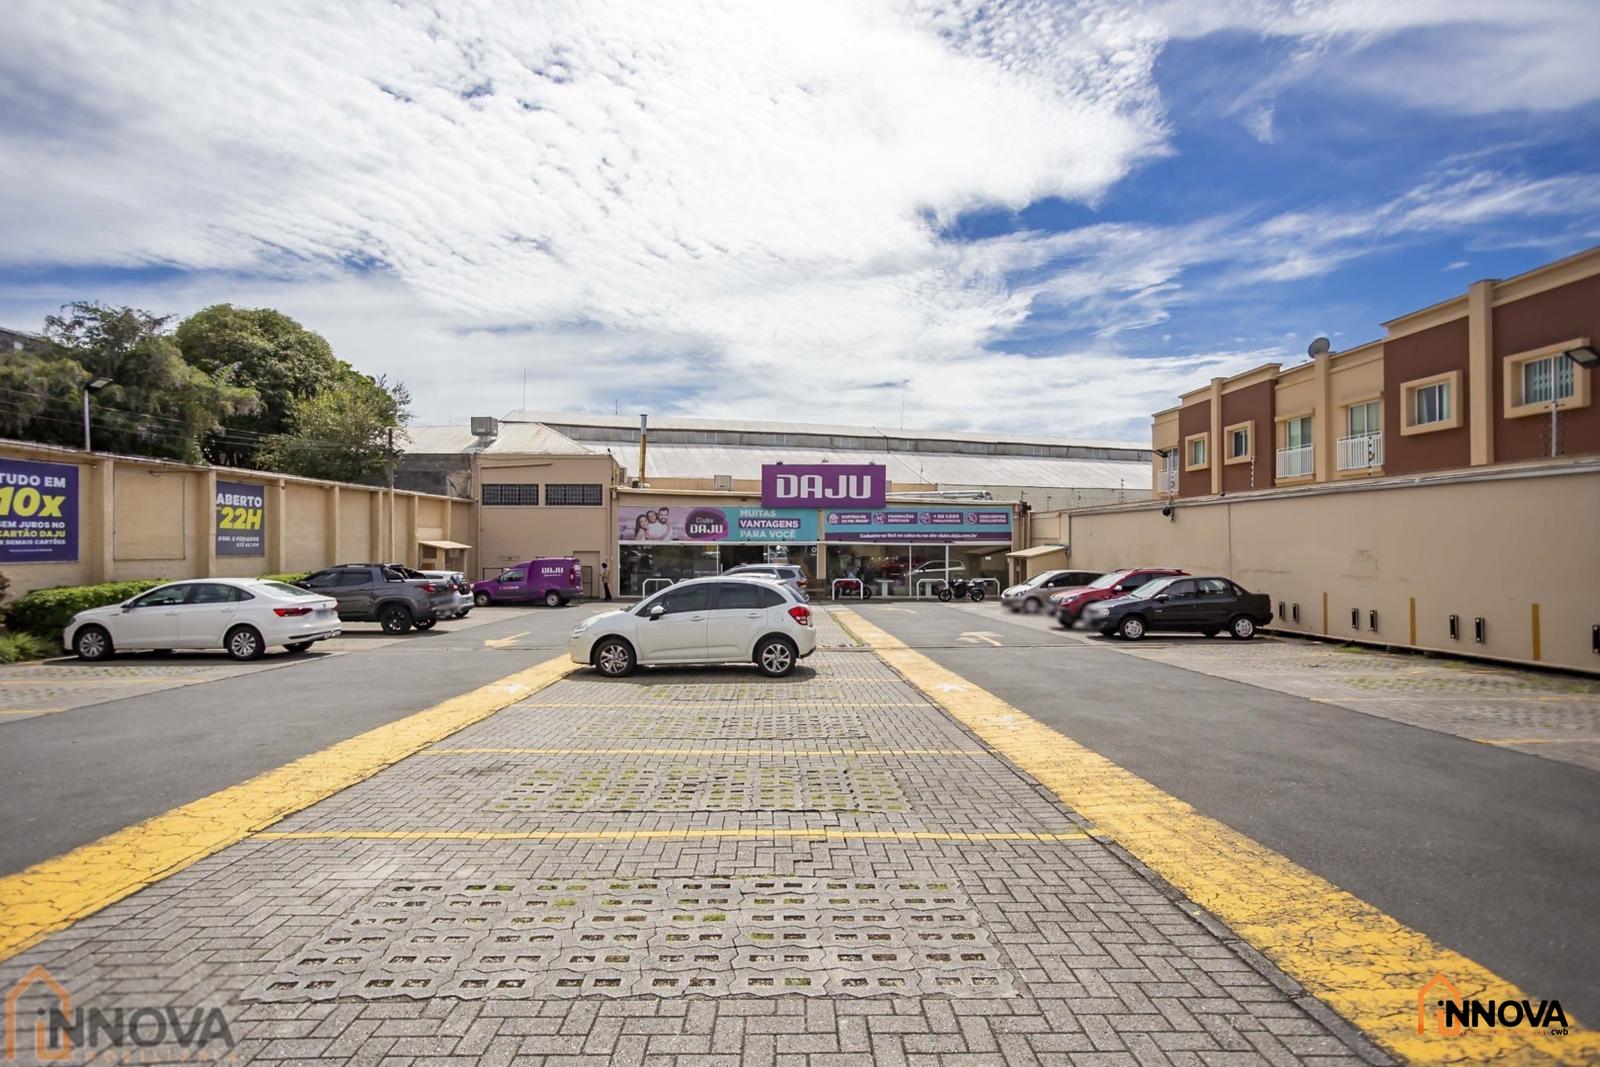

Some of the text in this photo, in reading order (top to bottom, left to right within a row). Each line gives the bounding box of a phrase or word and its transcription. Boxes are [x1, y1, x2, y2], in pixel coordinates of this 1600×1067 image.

[44, 476, 66, 489] EM
[776, 474, 871, 499] DAJU
[0, 486, 66, 517] 10x
[216, 493, 262, 507] ABERTO
[219, 506, 262, 530] 22H
[740, 509, 776, 517] MUITAS
[19, 521, 51, 529] JUROS
[689, 524, 723, 534] DAJU
[740, 520, 799, 528] VANTAGENS
[769, 529, 796, 538] VOCÊ
